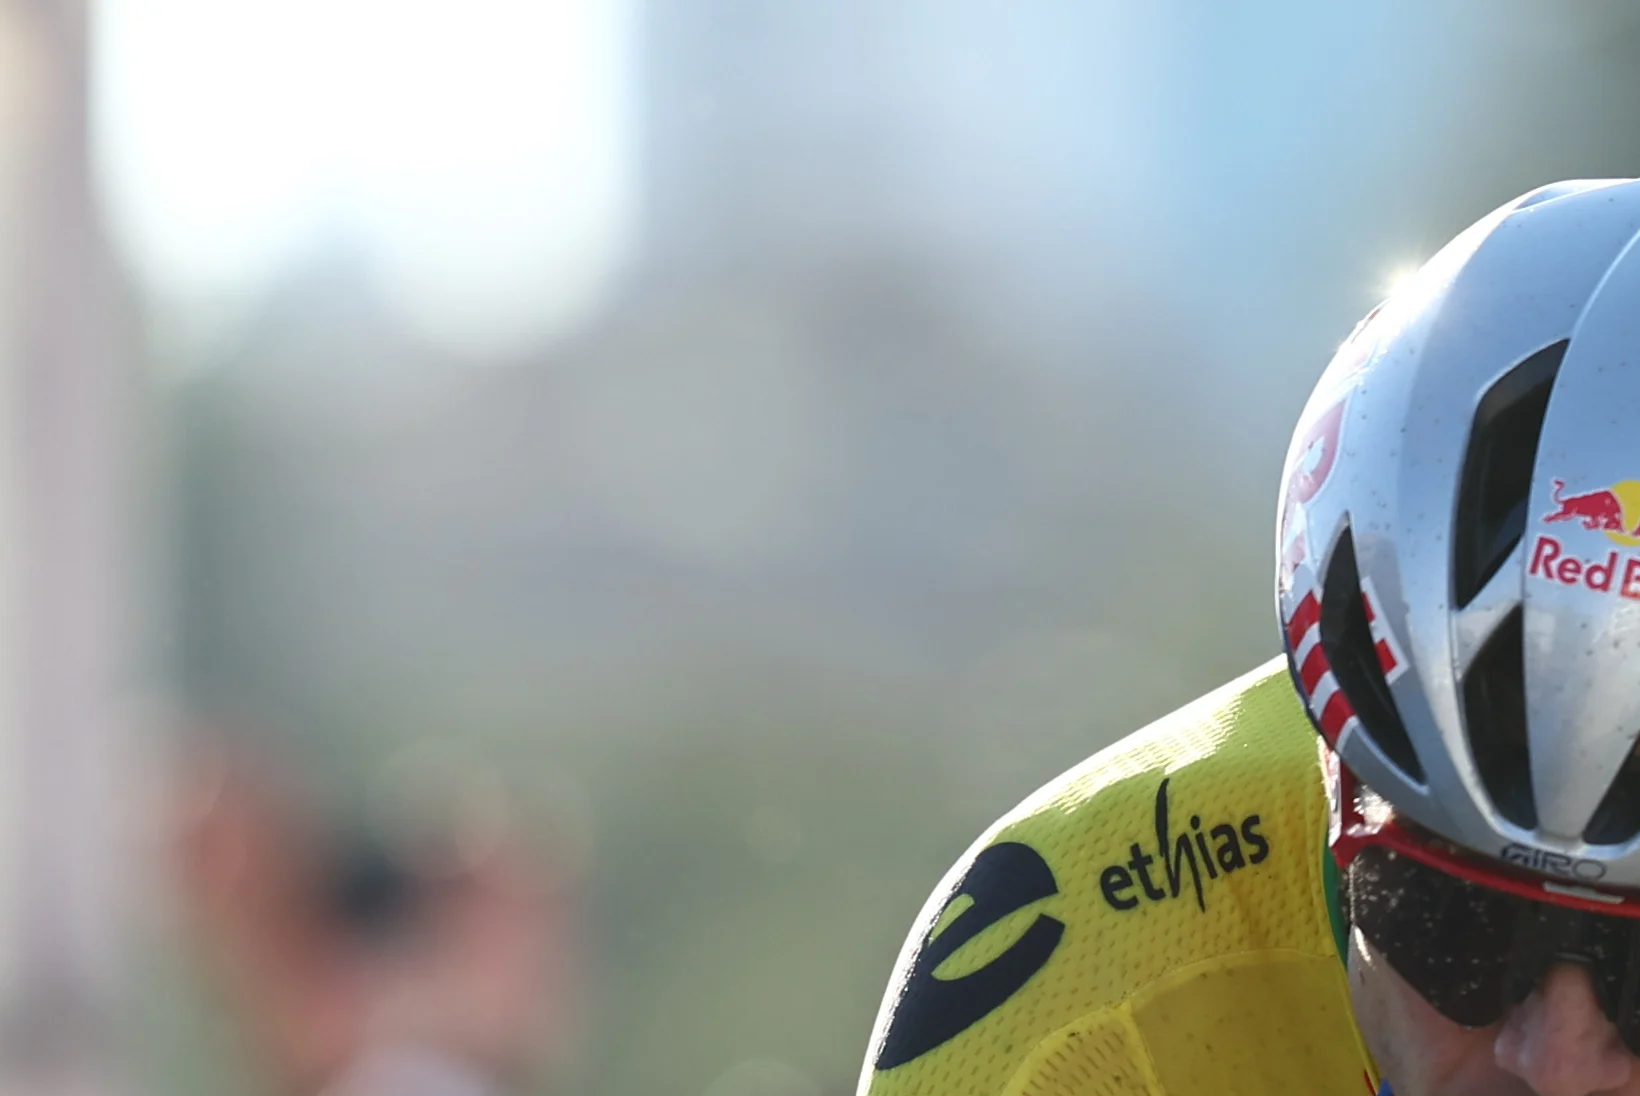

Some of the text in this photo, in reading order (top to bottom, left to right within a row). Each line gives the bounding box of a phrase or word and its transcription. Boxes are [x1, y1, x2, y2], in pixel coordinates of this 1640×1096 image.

[1529, 536, 1619, 592] Red
[1101, 778, 1269, 913] ethias
[1501, 842, 1606, 881] GIRO
